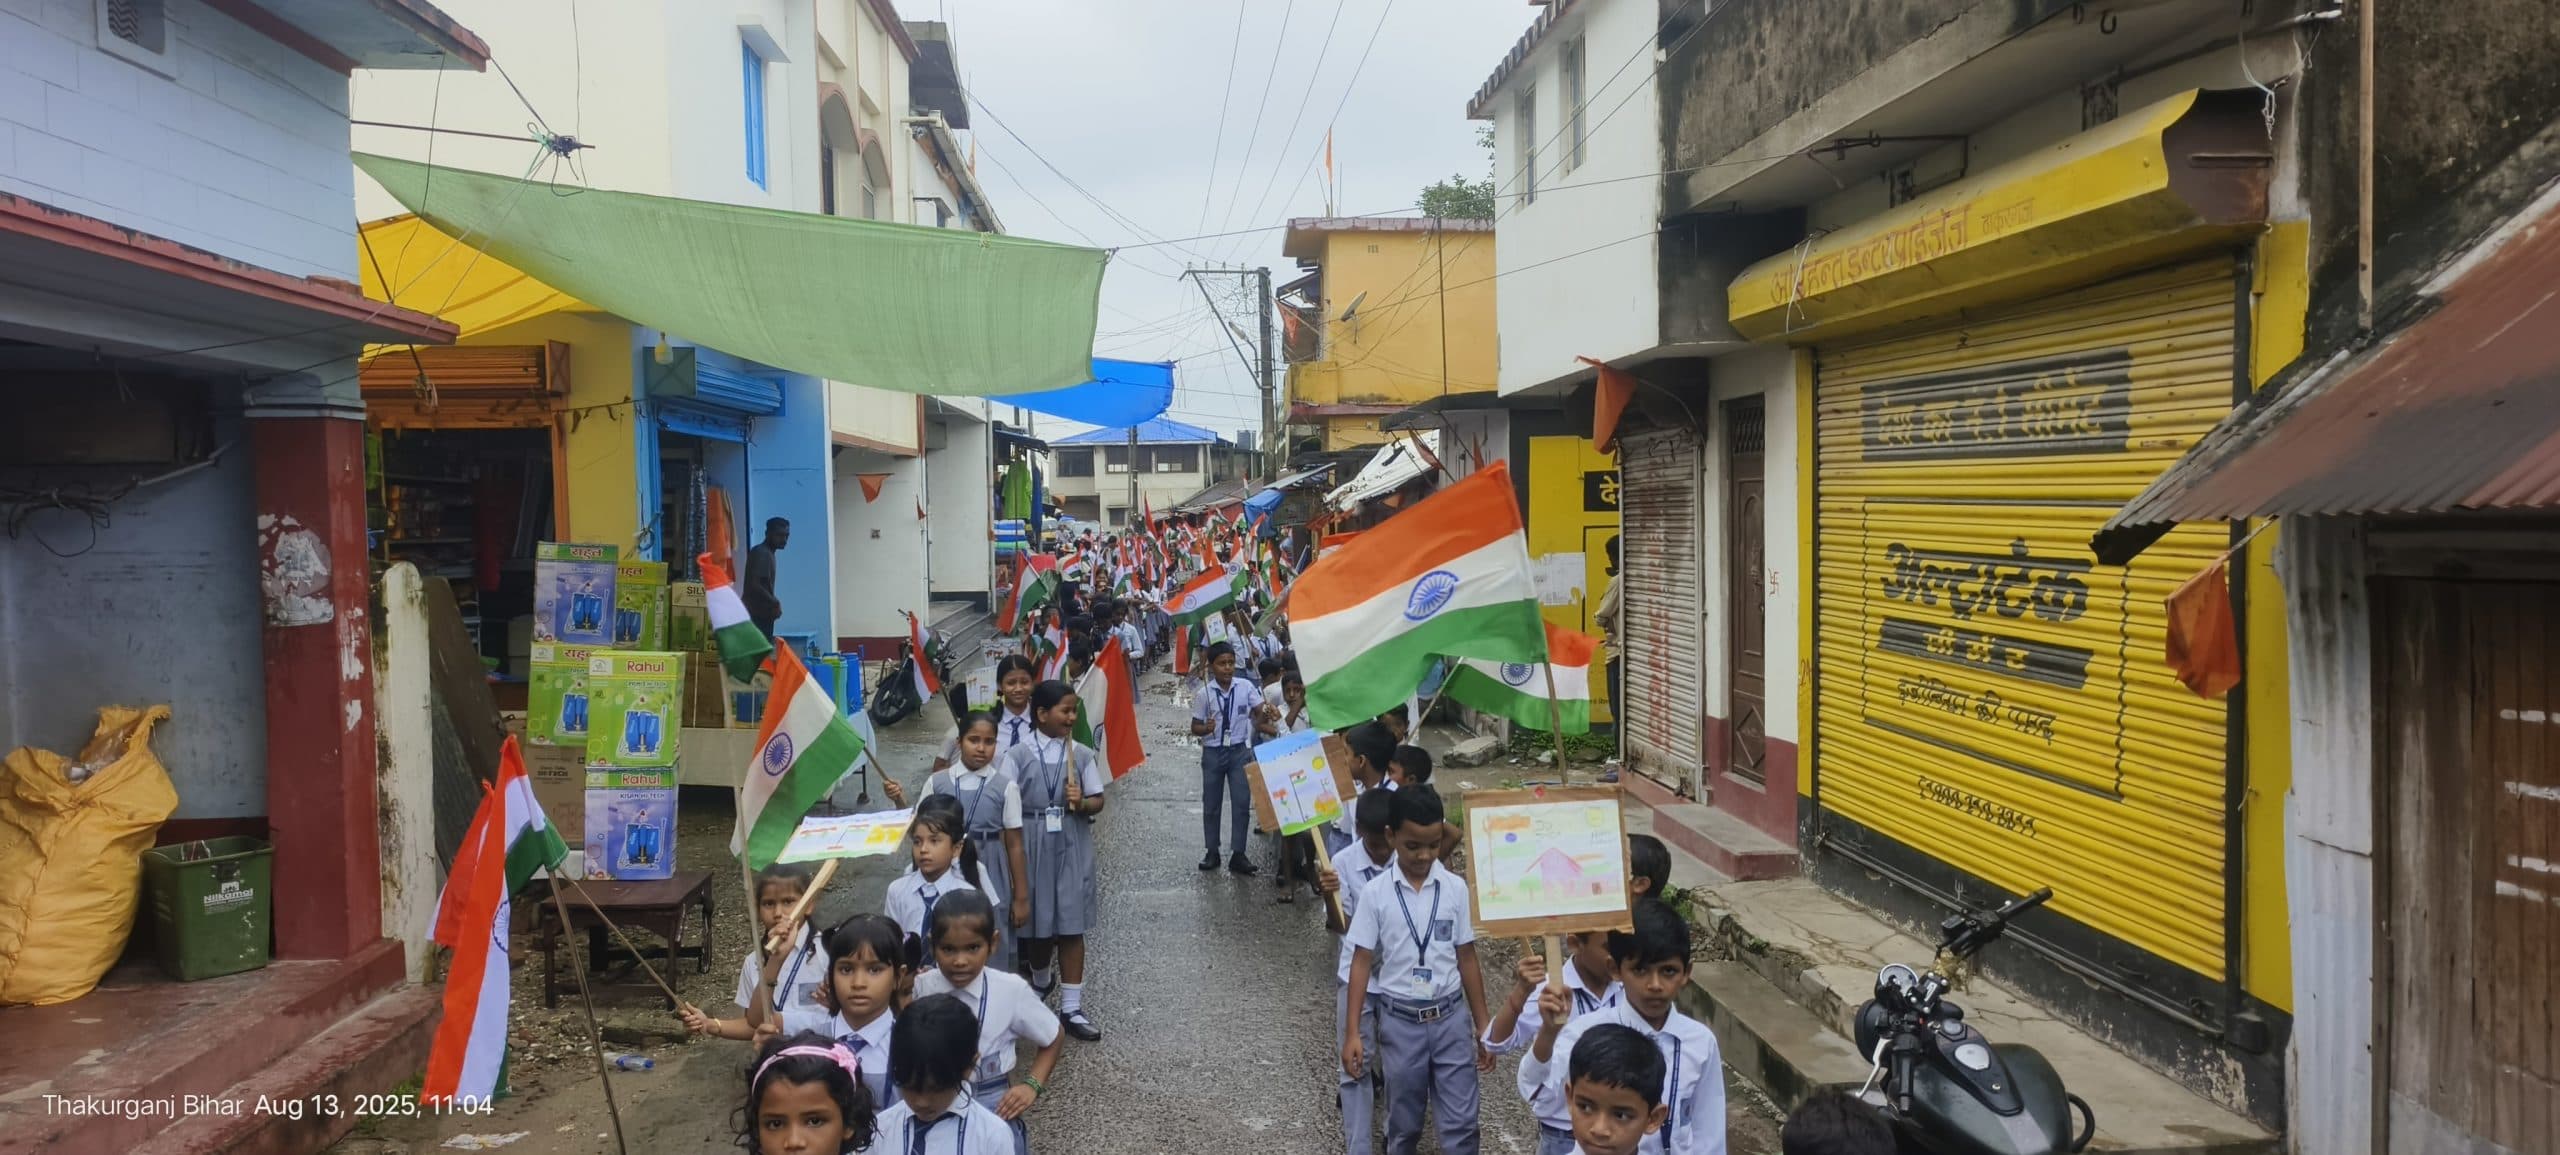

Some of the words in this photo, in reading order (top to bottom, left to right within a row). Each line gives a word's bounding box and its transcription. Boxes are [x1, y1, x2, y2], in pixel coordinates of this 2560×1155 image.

[1878, 392, 1917, 447] देश
[1921, 401, 1959, 444] का
[2020, 367, 2110, 440] सीमेंट
[1599, 474, 1620, 505] दे
[570, 546, 603, 560] राहुल
[627, 660, 665, 673] Rahul
[622, 774, 661, 785] Rahul
[203, 887, 254, 904] Nilkamal
